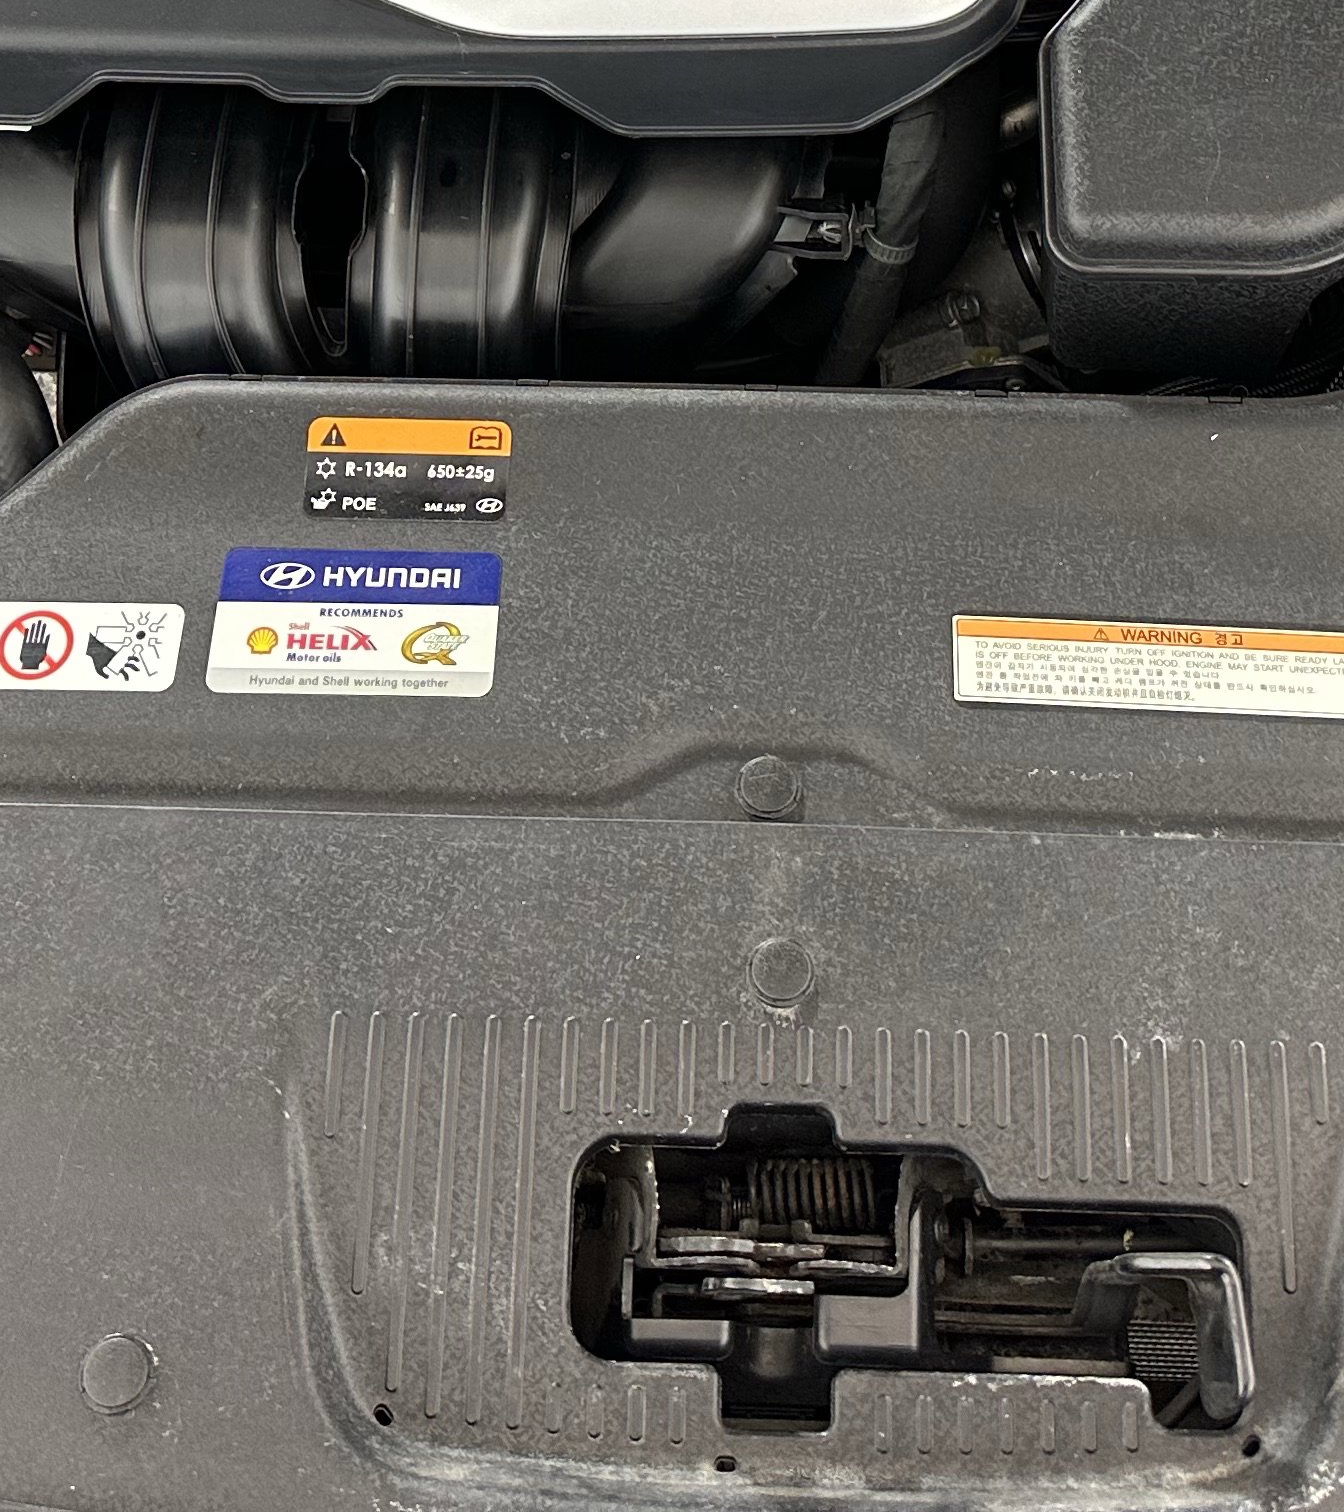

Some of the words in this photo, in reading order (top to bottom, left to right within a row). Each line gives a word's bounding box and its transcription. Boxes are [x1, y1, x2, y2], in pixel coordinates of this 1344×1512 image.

[345, 461, 407, 478] R-134a
[427, 464, 495, 483] 650±25g
[341, 496, 377, 511] POE
[424, 502, 443, 512] SAE
[322, 566, 461, 589] HYUNDAI
[319, 607, 404, 619] RECOMMENDS
[288, 622, 311, 631] Shell
[286, 631, 377, 651] HELIX
[1121, 627, 1203, 645] WARNING
[1215, 632, 1243, 647] 경고
[286, 652, 321, 663] Motor
[322, 653, 342, 663] oils
[975, 640, 988, 649] TO
[992, 641, 1021, 650] AVOID
[1026, 642, 1069, 653] SERIOUS
[1074, 645, 1108, 655] INJURY
[1115, 647, 1142, 656] TURN
[1171, 649, 1214, 659] IGNITION
[1219, 652, 1239, 661] AND
[1295, 655, 1328, 665] READY
[975, 650, 984, 658] IS
[989, 651, 1008, 660] OFF
[1014, 652, 1053, 662] BEFORE
[1058, 654, 1105, 664] WORKING
[1110, 657, 1144, 666] UNDER
[1186, 660, 1223, 670] ENGINE
[1228, 662, 1248, 671] MAY
[1253, 663, 1284, 673] START
[249, 674, 295, 688] Hyundai
[299, 675, 318, 686] and
[322, 675, 349, 687] Shell
[354, 677, 398, 690] working
[401, 678, 449, 690] together
